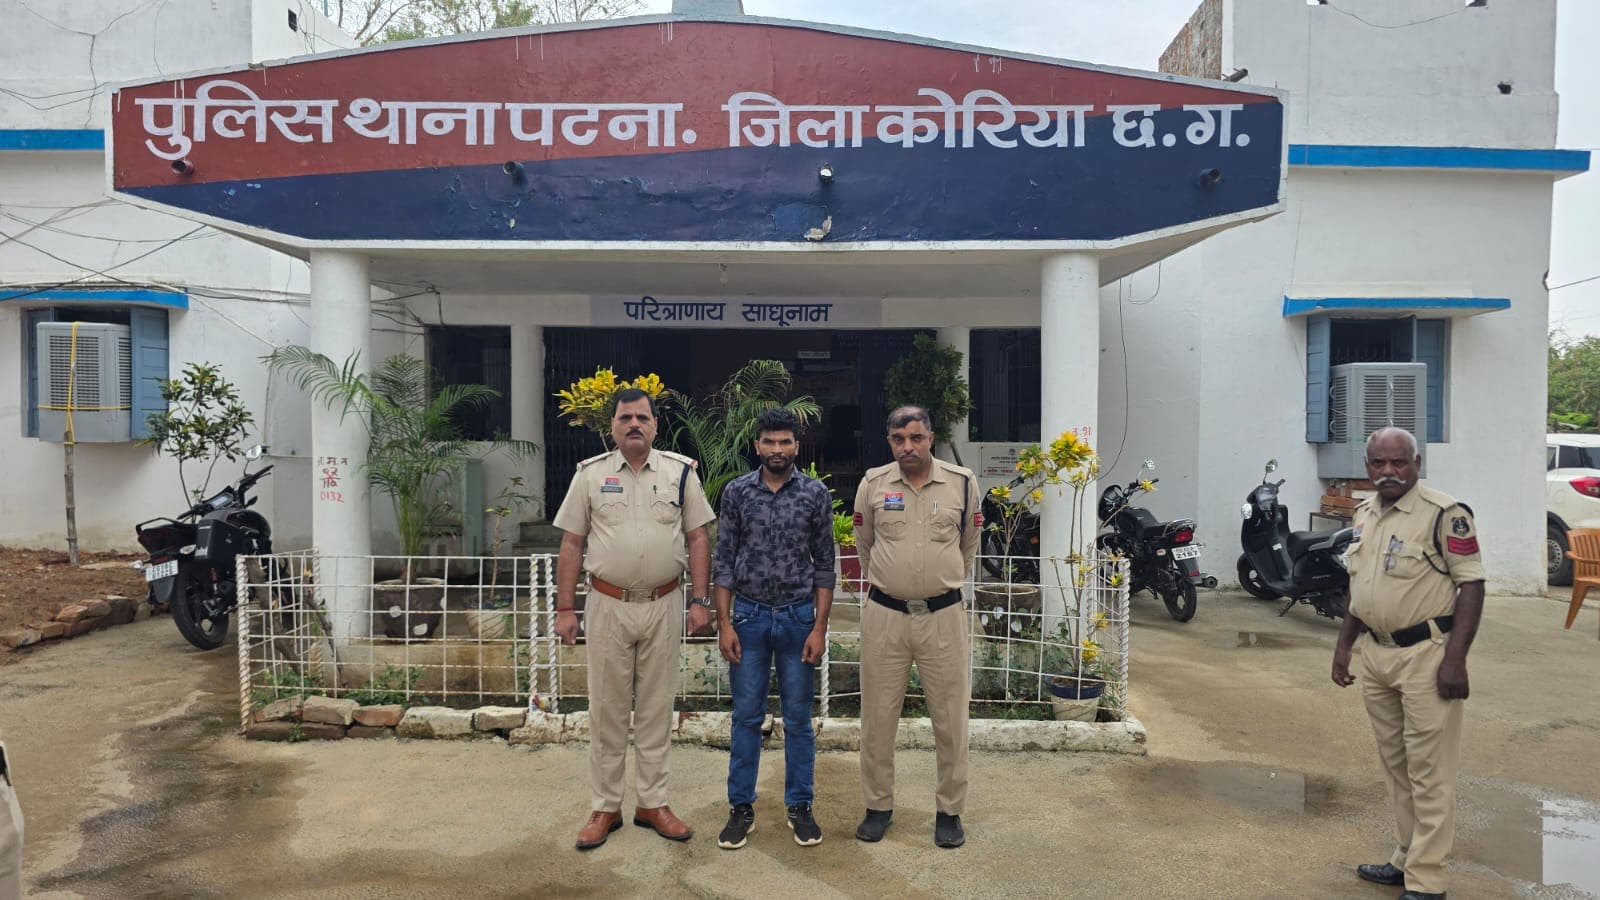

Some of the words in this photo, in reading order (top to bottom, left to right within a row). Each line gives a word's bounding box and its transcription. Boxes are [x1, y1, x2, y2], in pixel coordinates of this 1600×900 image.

[134, 79, 340, 161] पुलिस
[342, 97, 502, 146] थाना
[721, 91, 870, 149] जिला
[874, 87, 1094, 149] कोरिया
[623, 295, 727, 321] परित्राणाय
[742, 303, 833, 327] साधूनाम
